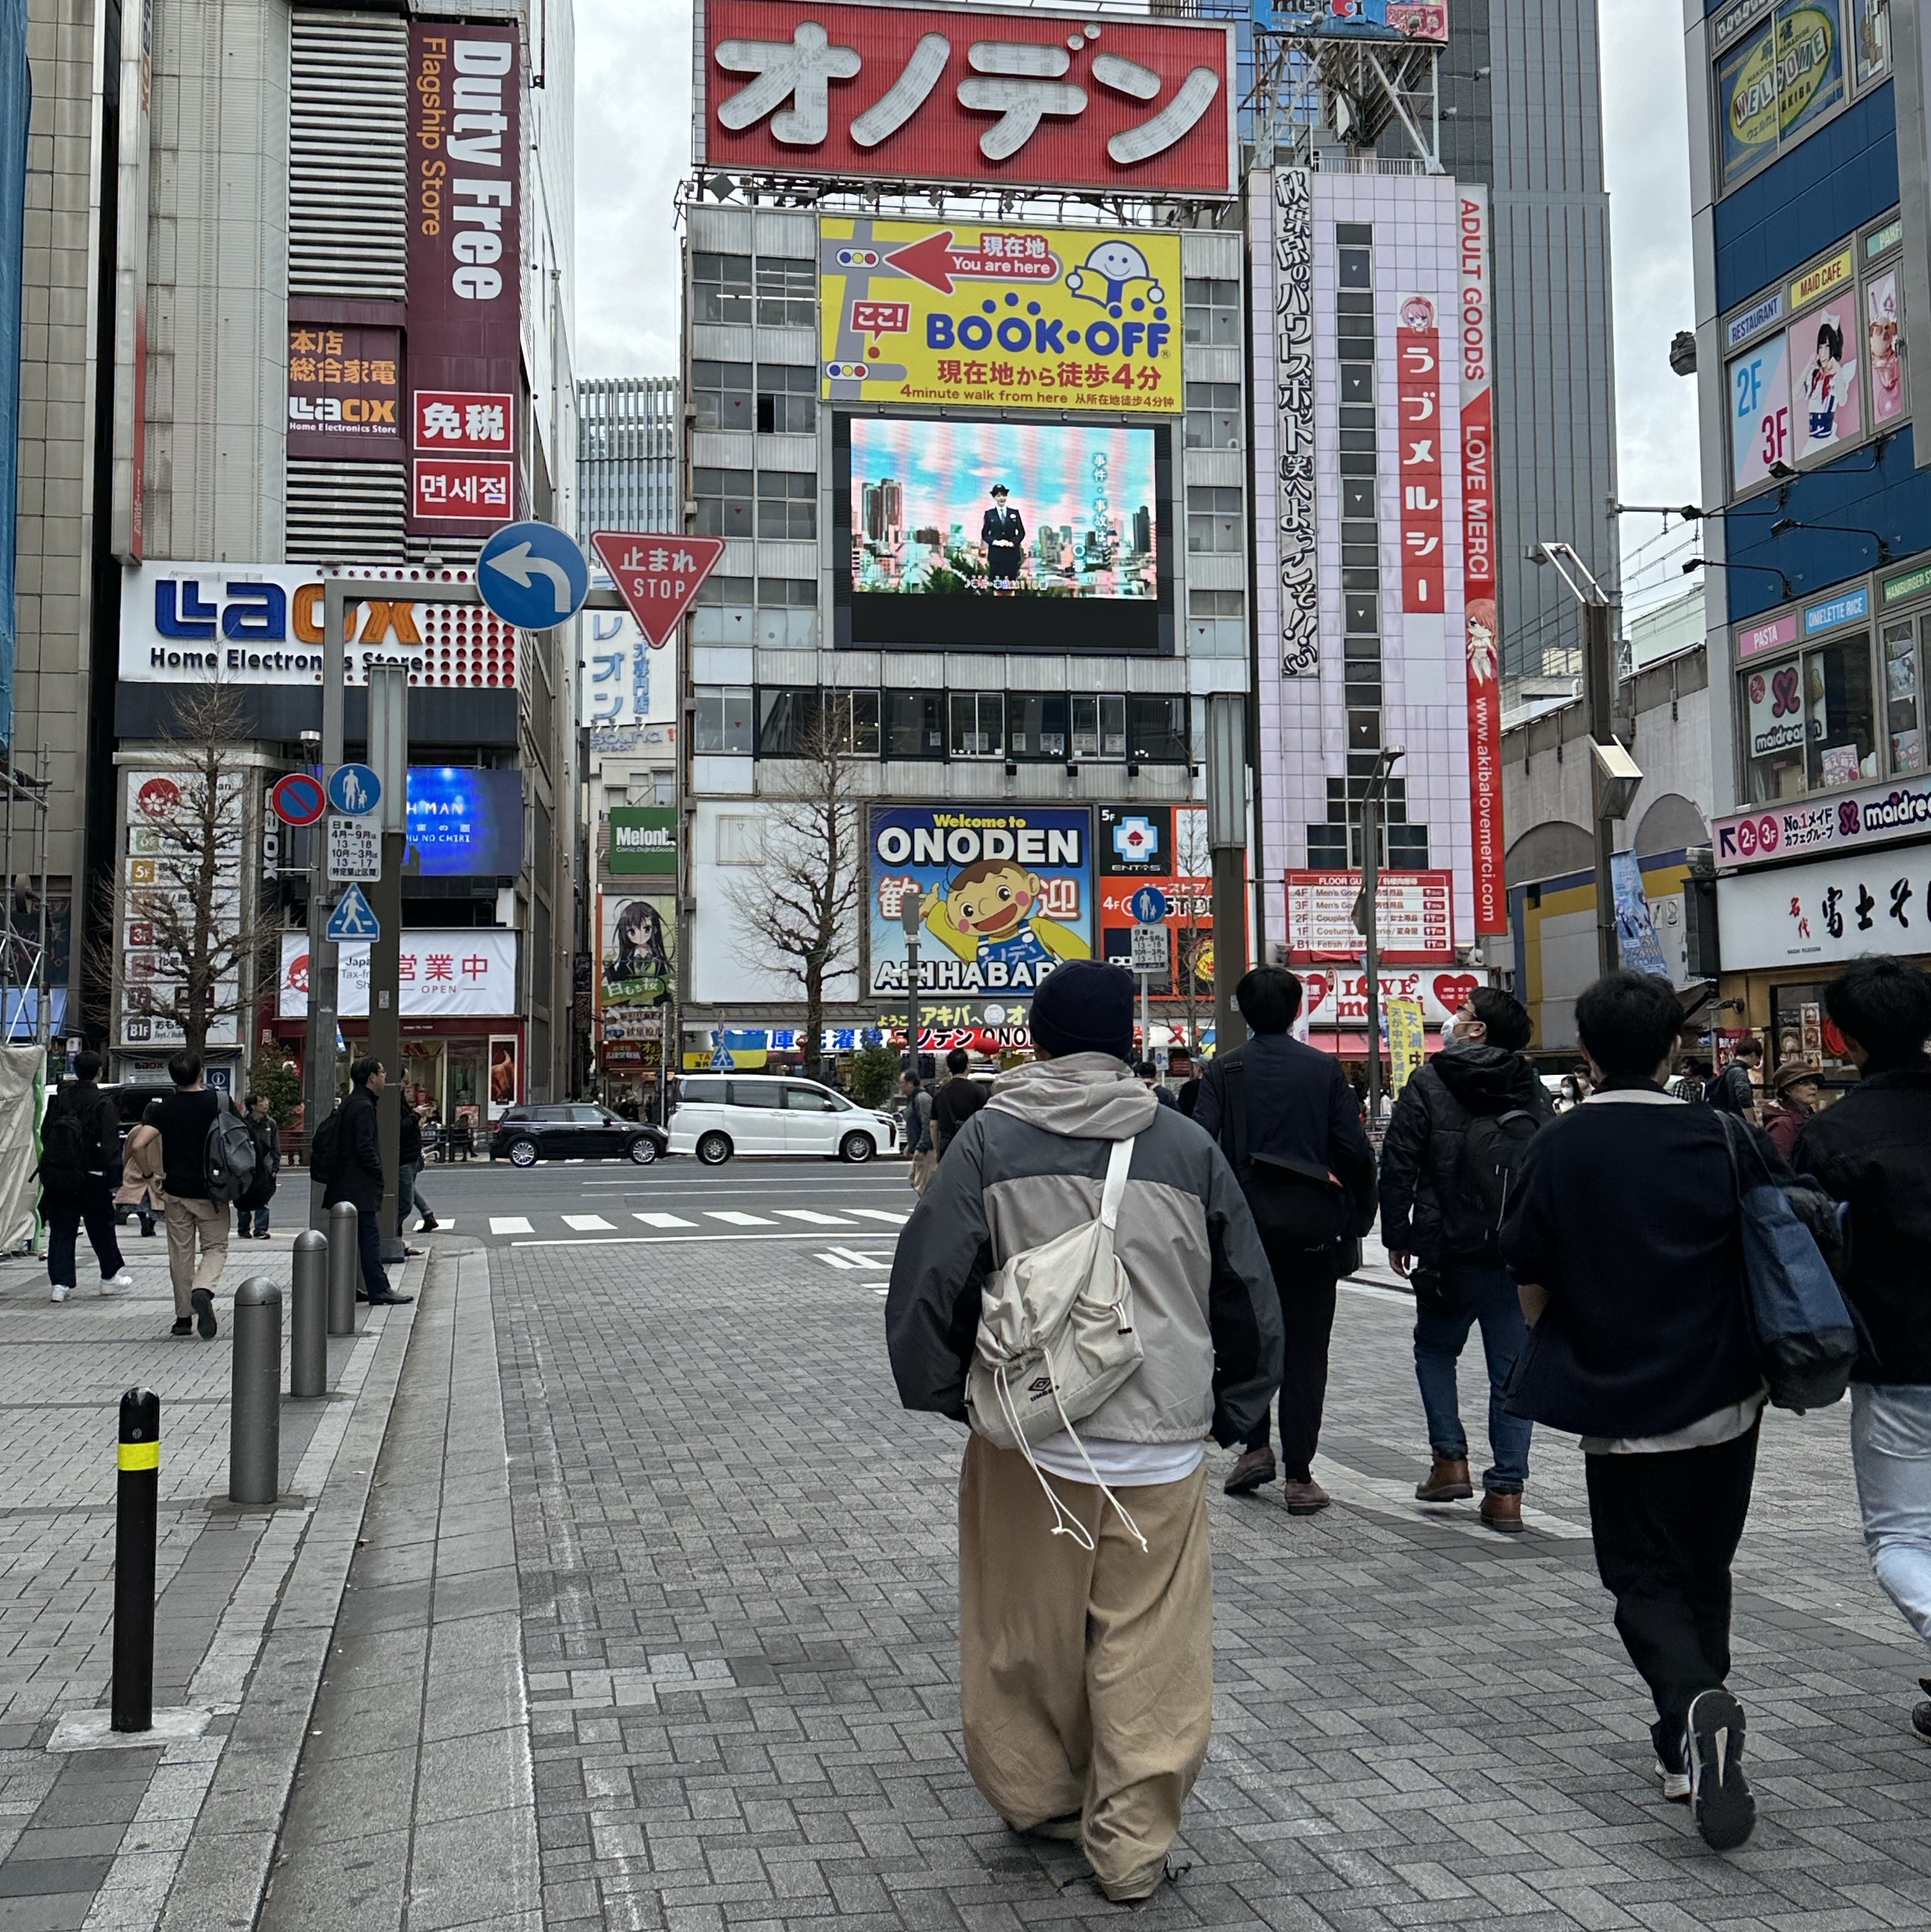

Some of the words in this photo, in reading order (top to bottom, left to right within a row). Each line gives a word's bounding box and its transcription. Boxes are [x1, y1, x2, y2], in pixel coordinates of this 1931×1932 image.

[416, 37, 446, 149] Flagship
[447, 40, 512, 166] Duty
[715, 20, 1219, 164] オノデン
[1781, 80, 1812, 114] AKIBA
[421, 160, 446, 236] Store
[452, 178, 512, 300] Free
[982, 236, 1046, 257] 現在地
[1461, 198, 1481, 280] ADULT
[952, 255, 982, 271] You
[984, 261, 1011, 273] are
[1013, 261, 1051, 275] here
[1800, 274, 1820, 298] MAID
[1822, 261, 1842, 287] CAFE
[858, 307, 904, 327] ここ!
[1732, 296, 1778, 344] RESTAURANT
[290, 329, 343, 355] 本店
[1462, 291, 1484, 381] GOODS
[289, 357, 396, 384] 総合家電
[937, 360, 1162, 390] 現在地から徒歩4分
[900, 384, 959, 400] 4minute
[965, 389, 995, 402] walk
[998, 390, 1034, 402] from
[1037, 390, 1068, 404] here
[1737, 358, 1762, 418] 2F
[289, 422, 316, 431] Home
[318, 423, 370, 433] Electronics
[372, 425, 397, 434] Store
[423, 402, 505, 441] 免税
[1761, 406, 1788, 464] 3F
[1465, 425, 1486, 491] LOVE
[1401, 347, 1439, 602] ラブメルシー
[420, 474, 507, 505] 면세점
[1467, 498, 1489, 581] MERCI
[620, 546, 698, 574] 止まれ
[633, 578, 685, 599] STOP
[1808, 602, 1845, 627] OMELETTE
[1846, 597, 1863, 616] RICE
[1753, 625, 1778, 650] PASTA
[150, 647, 218, 668] Home
[227, 648, 353, 670] Electrons
[592, 614, 625, 720] レオン
[933, 813, 1006, 828] Welcome
[1009, 815, 1027, 828] to
[1101, 809, 1115, 821] 5F
[1476, 696, 1495, 922] www.akibalovemerci.com
[876, 826, 1079, 863] ONODEN
[1741, 828, 1756, 848] 2F
[1762, 823, 1777, 843] 3F
[1785, 826, 1834, 846] カフェグループ
[135, 865, 151, 879] 5F
[1318, 877, 1348, 886] FLOOR
[1039, 878, 1080, 919] 迎
[1103, 896, 1120, 910] 4F
[1295, 889, 1308, 897] 4F
[1295, 901, 1309, 910] 3F
[1295, 914, 1309, 923] 2F
[1822, 877, 1931, 939] 富士そ
[132, 929, 149, 941] 3F
[1296, 927, 1309, 936] 1F
[1317, 927, 1354, 935] Costume
[1297, 939, 1309, 949] B1
[345, 957, 371, 968] Japa
[399, 954, 489, 982] 営業中
[421, 985, 457, 994] OPEN
[129, 1024, 149, 1037] B1F
